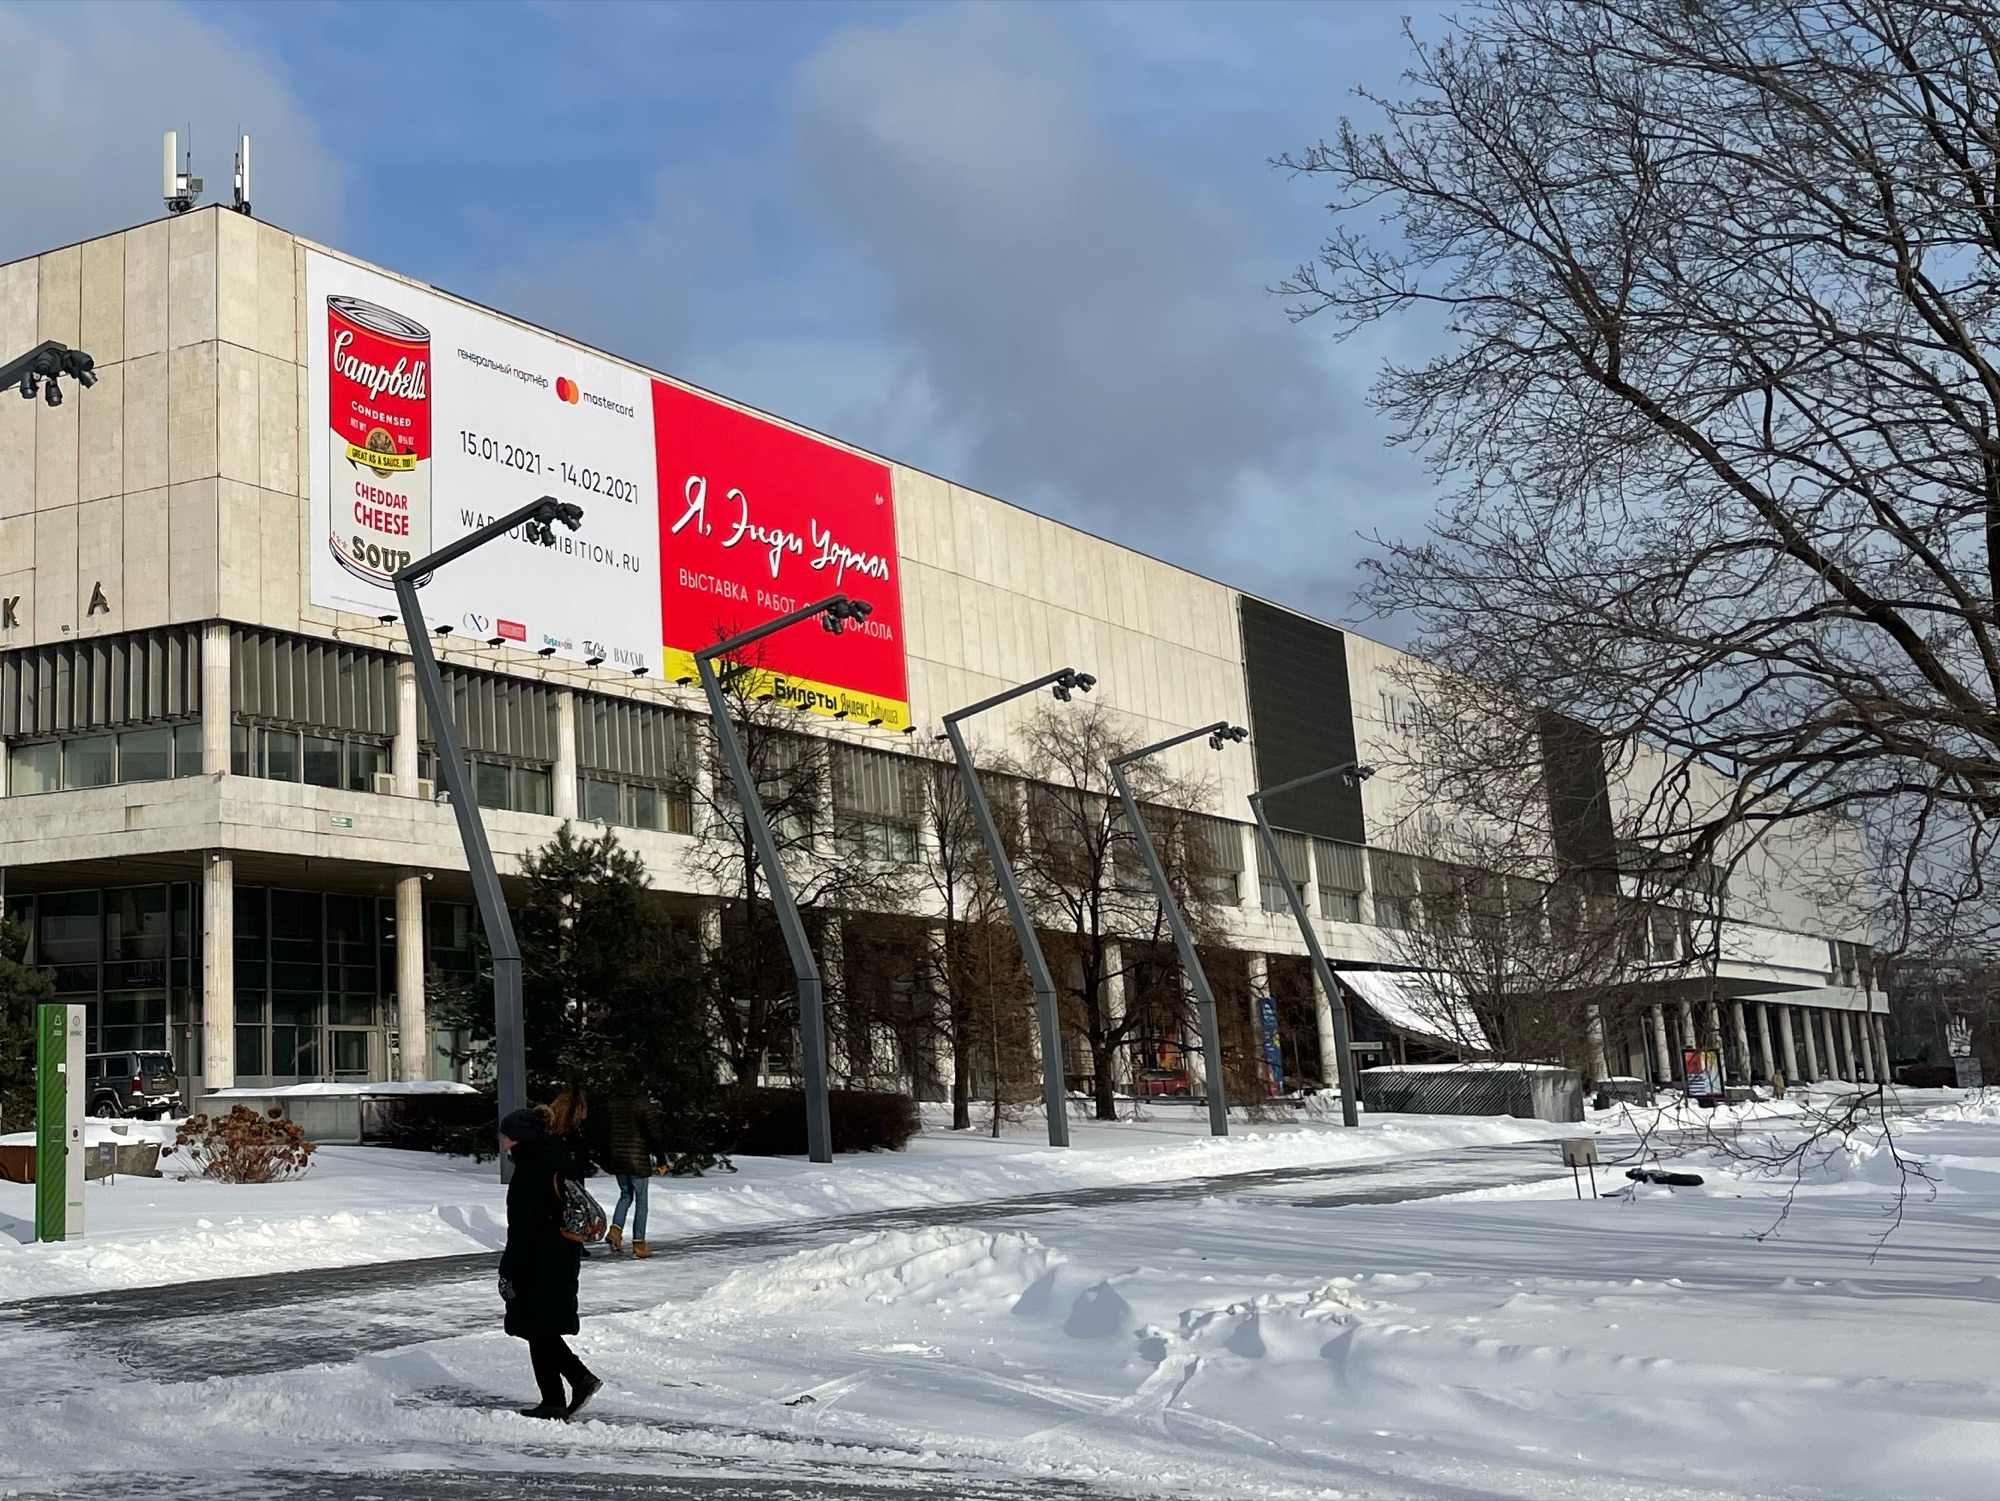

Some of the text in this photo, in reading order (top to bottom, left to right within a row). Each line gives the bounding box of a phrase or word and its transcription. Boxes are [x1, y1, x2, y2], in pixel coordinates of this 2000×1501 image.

[457, 348, 549, 390] генеральный партнёр
[351, 400, 412, 427] CONDENSED
[583, 391, 635, 418] mastercard
[352, 447, 368, 461] GREAT
[369, 453, 377, 464] AS
[377, 455, 382, 465] A
[460, 430, 541, 475] 15.01.2021
[560, 462, 638, 505] 14.02.2021
[355, 481, 408, 511] CHEDDAR
[354, 501, 409, 536] CHEESE
[671, 475, 890, 587] Я, Энди Уорхол
[352, 535, 411, 572] SOUP
[679, 568, 749, 602] ВЫСТАВКА
[757, 589, 796, 614] РАБОТ
[774, 677, 899, 724] Билеты Яндекс Афиша
